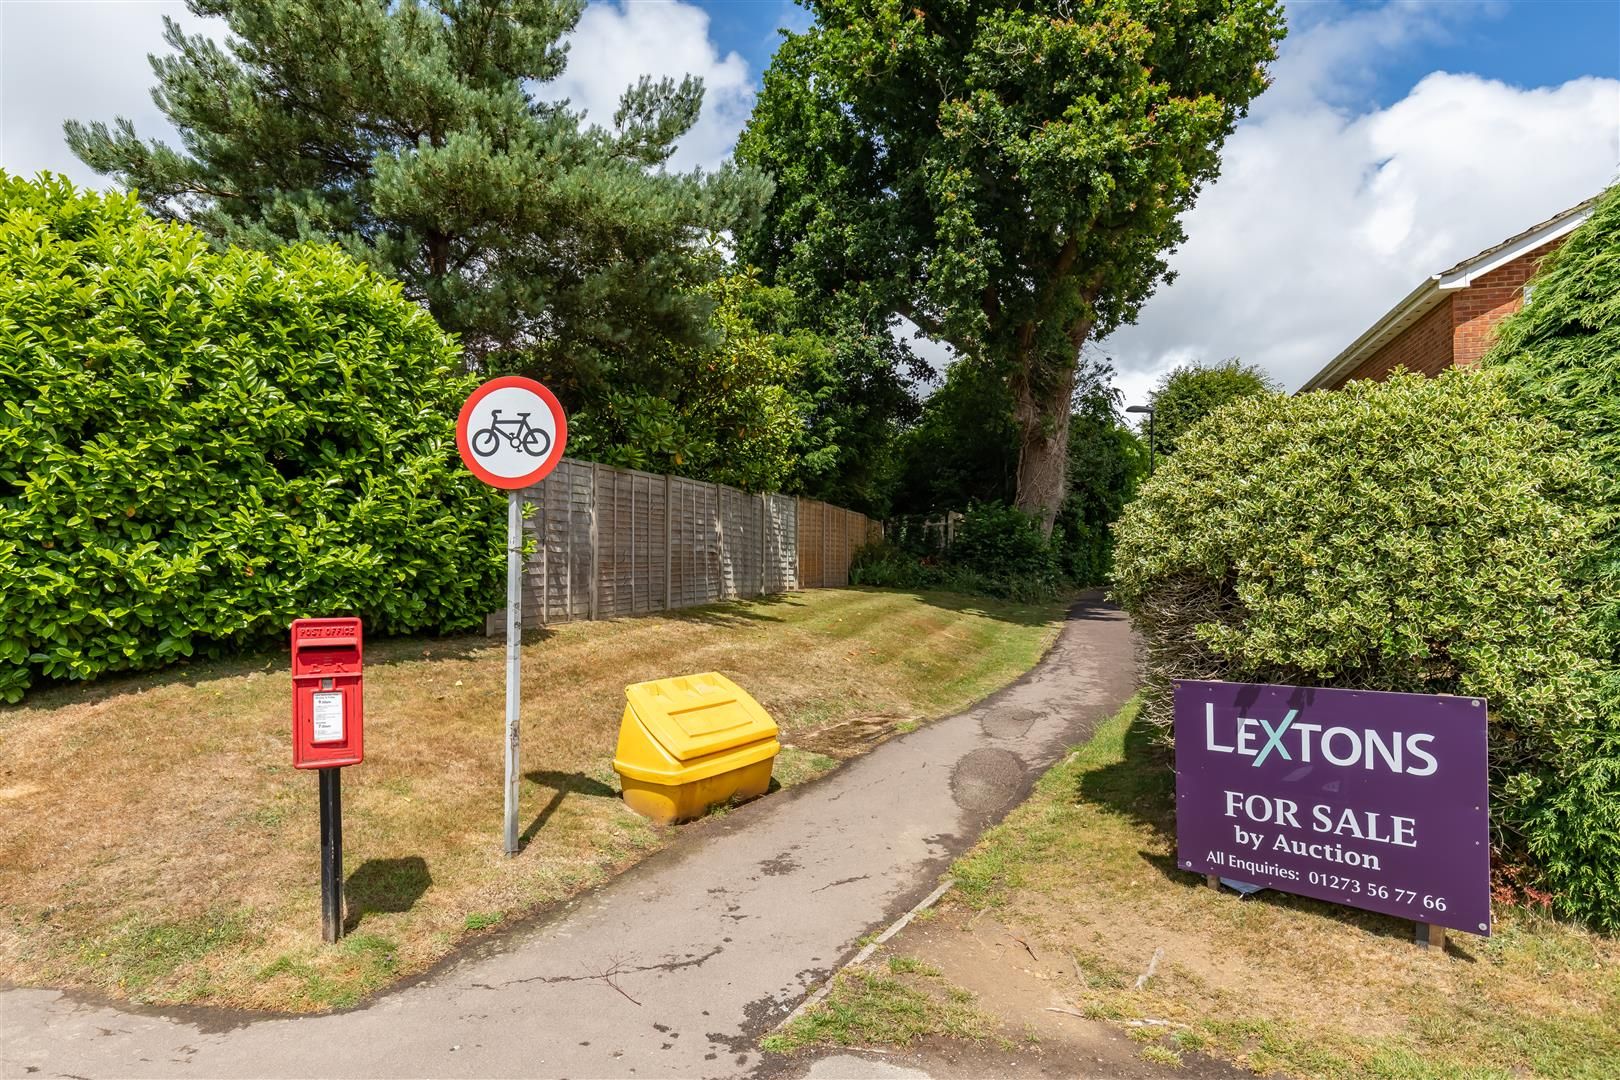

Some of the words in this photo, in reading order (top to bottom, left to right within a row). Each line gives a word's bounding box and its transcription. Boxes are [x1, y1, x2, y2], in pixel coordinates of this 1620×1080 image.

[300, 627, 323, 637] POST
[325, 626, 355, 636] OFFICE
[1205, 703, 1438, 776] LEXTONS
[1224, 790, 1301, 828] FOR
[1312, 804, 1417, 848] SALE
[1234, 826, 1264, 850] by
[1272, 834, 1381, 871] Auction
[1206, 851, 1225, 865] All
[1229, 855, 1300, 881] Enquiries:
[1309, 871, 1361, 893] 01273
[1367, 883, 1389, 899] 56
[1394, 889, 1417, 905] 77
[1423, 895, 1447, 912] 66
